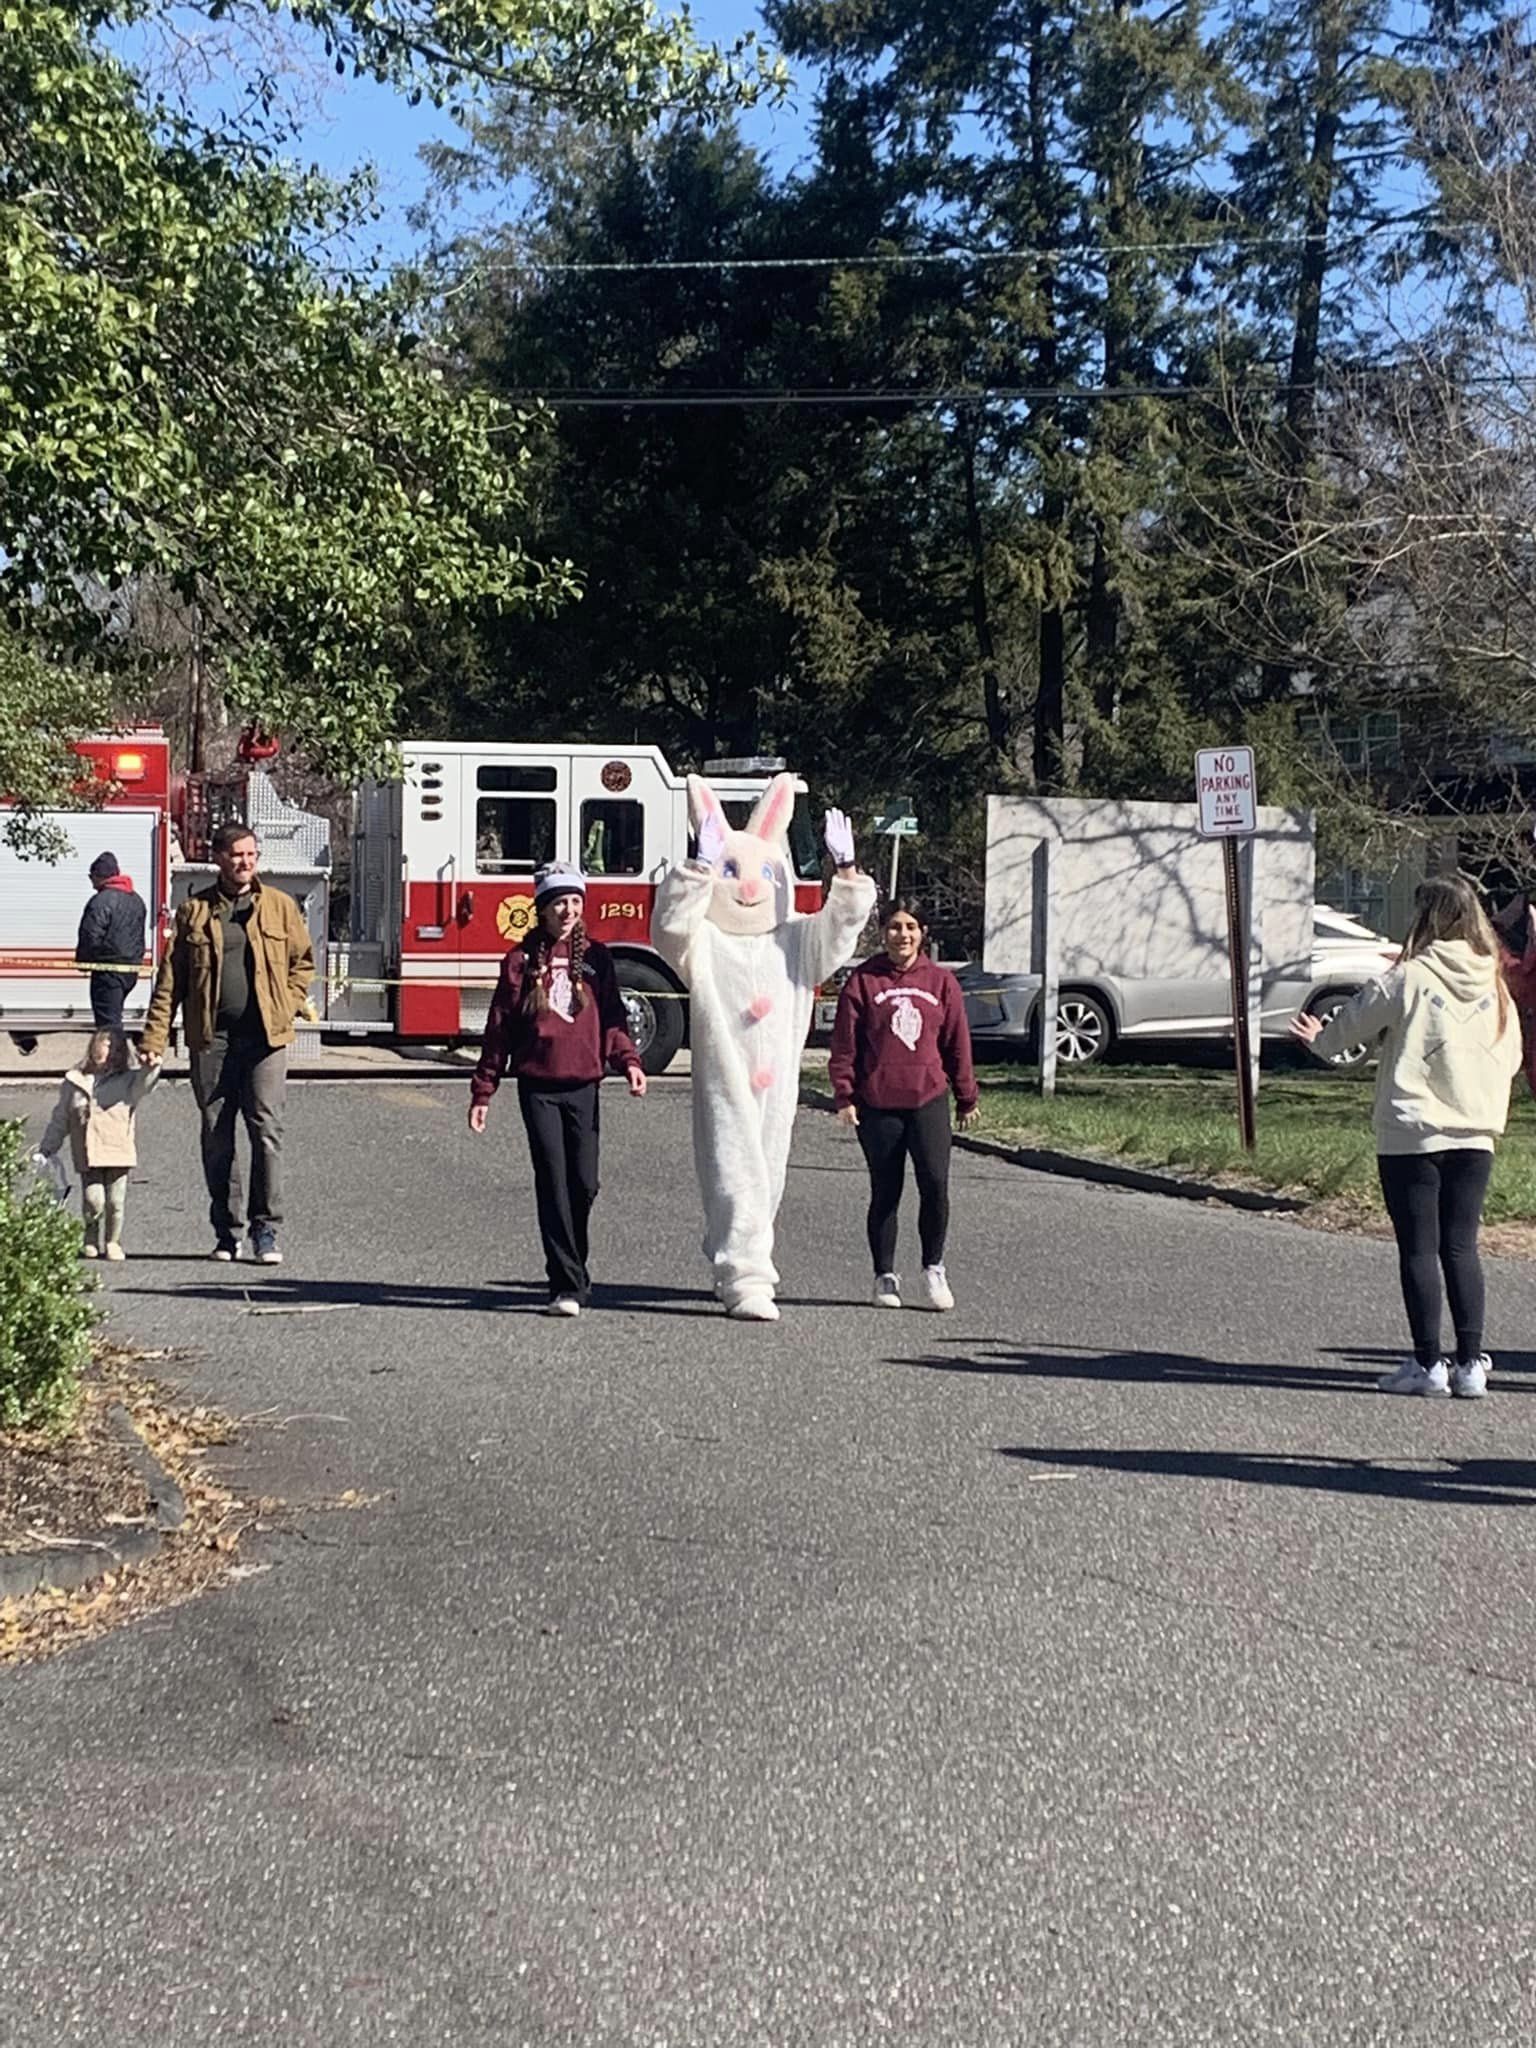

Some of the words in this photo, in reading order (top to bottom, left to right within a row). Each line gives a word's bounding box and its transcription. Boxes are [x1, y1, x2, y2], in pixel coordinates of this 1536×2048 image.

[1214, 754, 1235, 773] NO
[1201, 774, 1250, 793] PARKING
[1216, 792, 1237, 804] ANY
[1215, 804, 1241, 817] TIME
[600, 903, 644, 920] 1291
